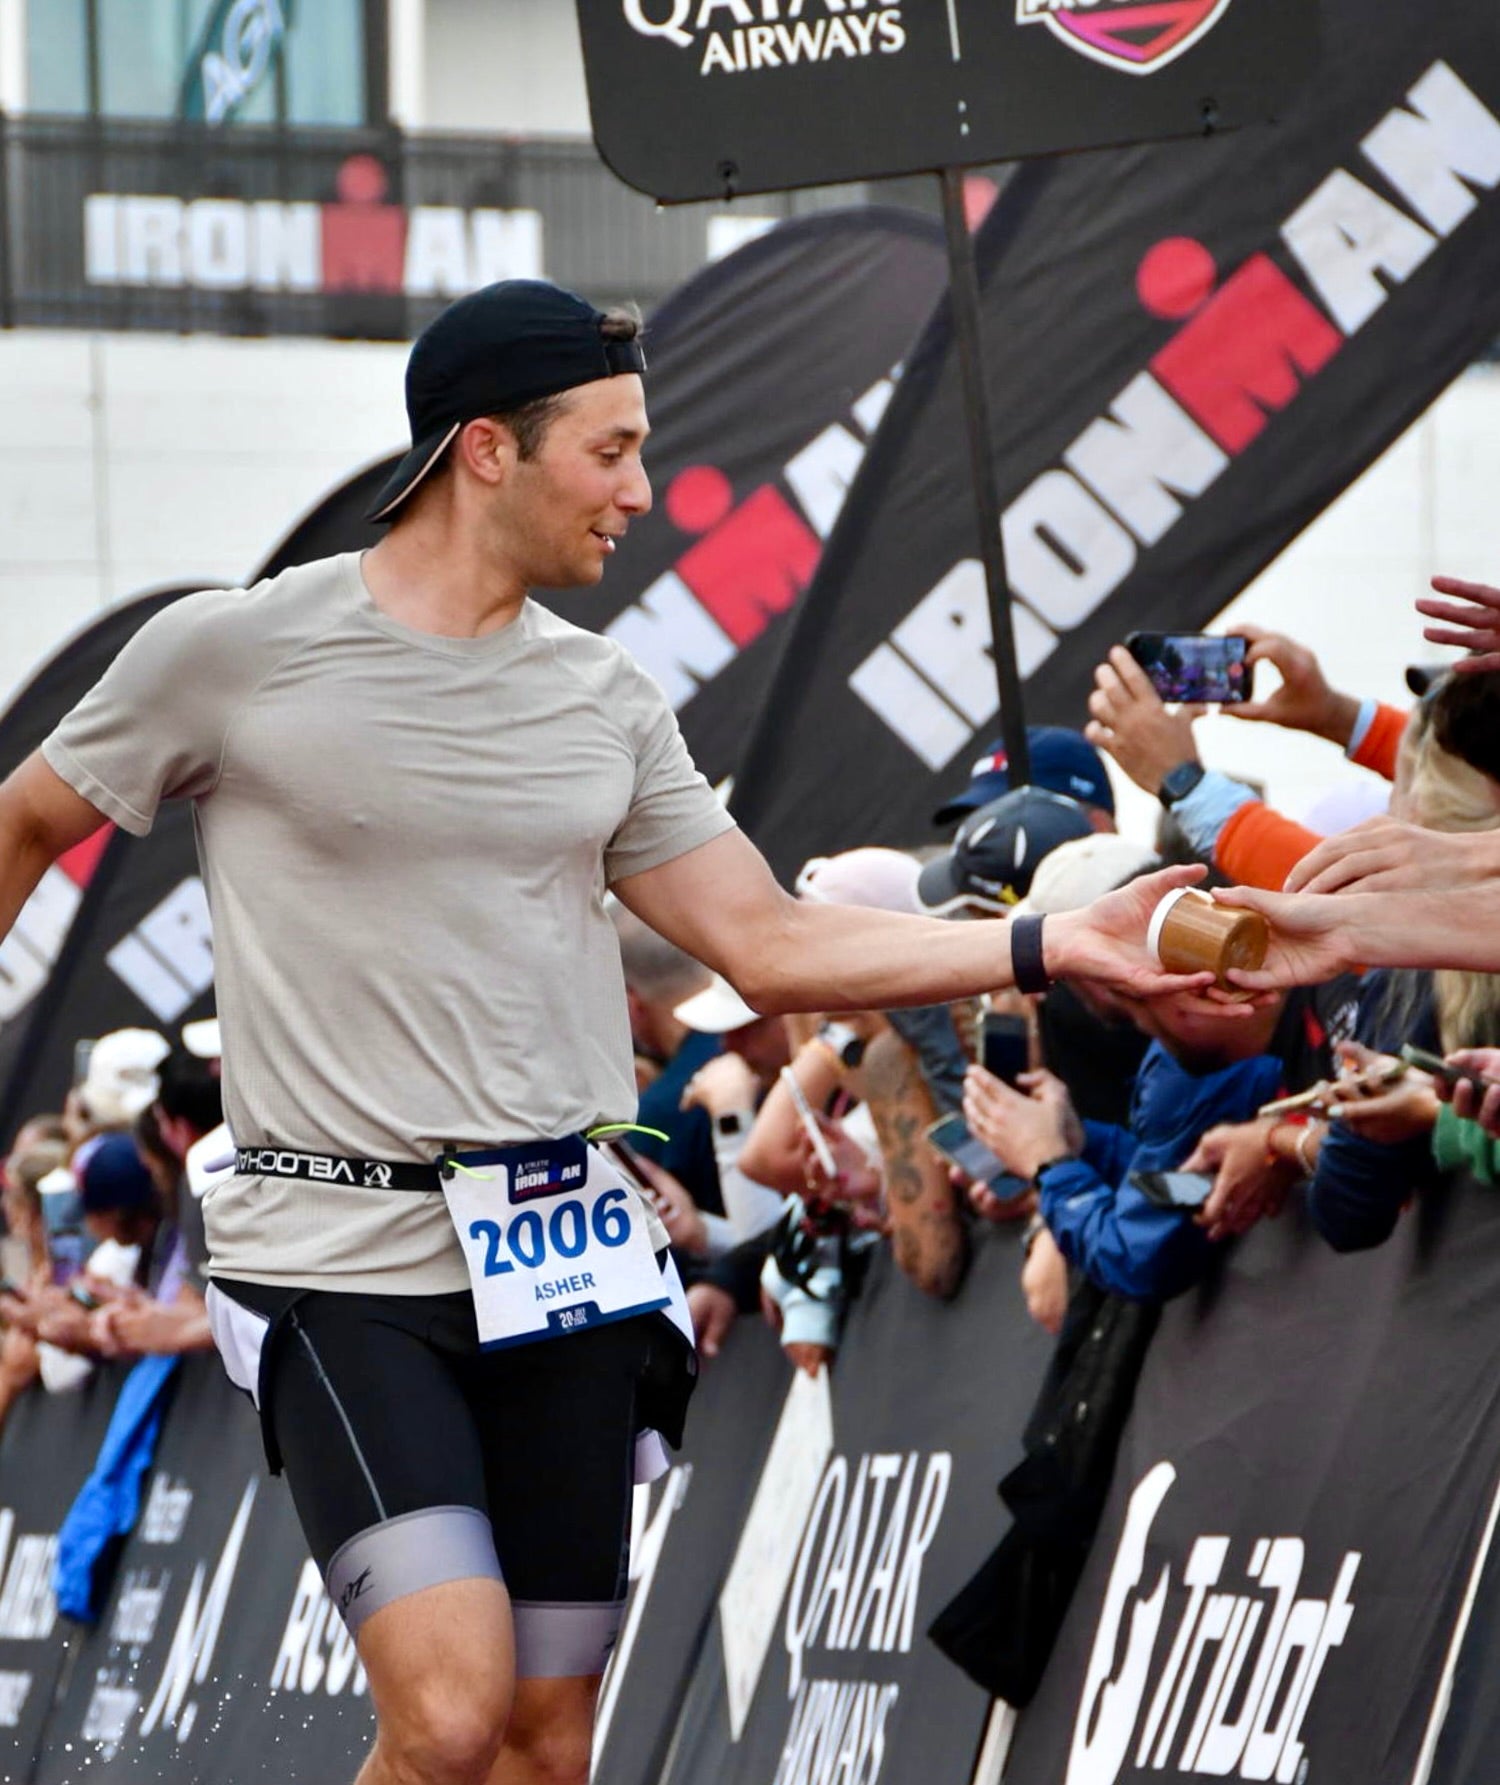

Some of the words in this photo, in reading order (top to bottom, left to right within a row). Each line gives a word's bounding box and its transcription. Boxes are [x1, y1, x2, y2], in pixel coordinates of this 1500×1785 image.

[701, 9, 906, 76] AIRWAYS
[84, 154, 543, 296] IRONMAN
[847, 58, 1500, 773] IRONMAN
[235, 1150, 355, 1183] VELOCHA
[469, 1188, 631, 1277] 2006
[535, 1272, 596, 1302] ASHER
[785, 1450, 952, 1700] QATAR
